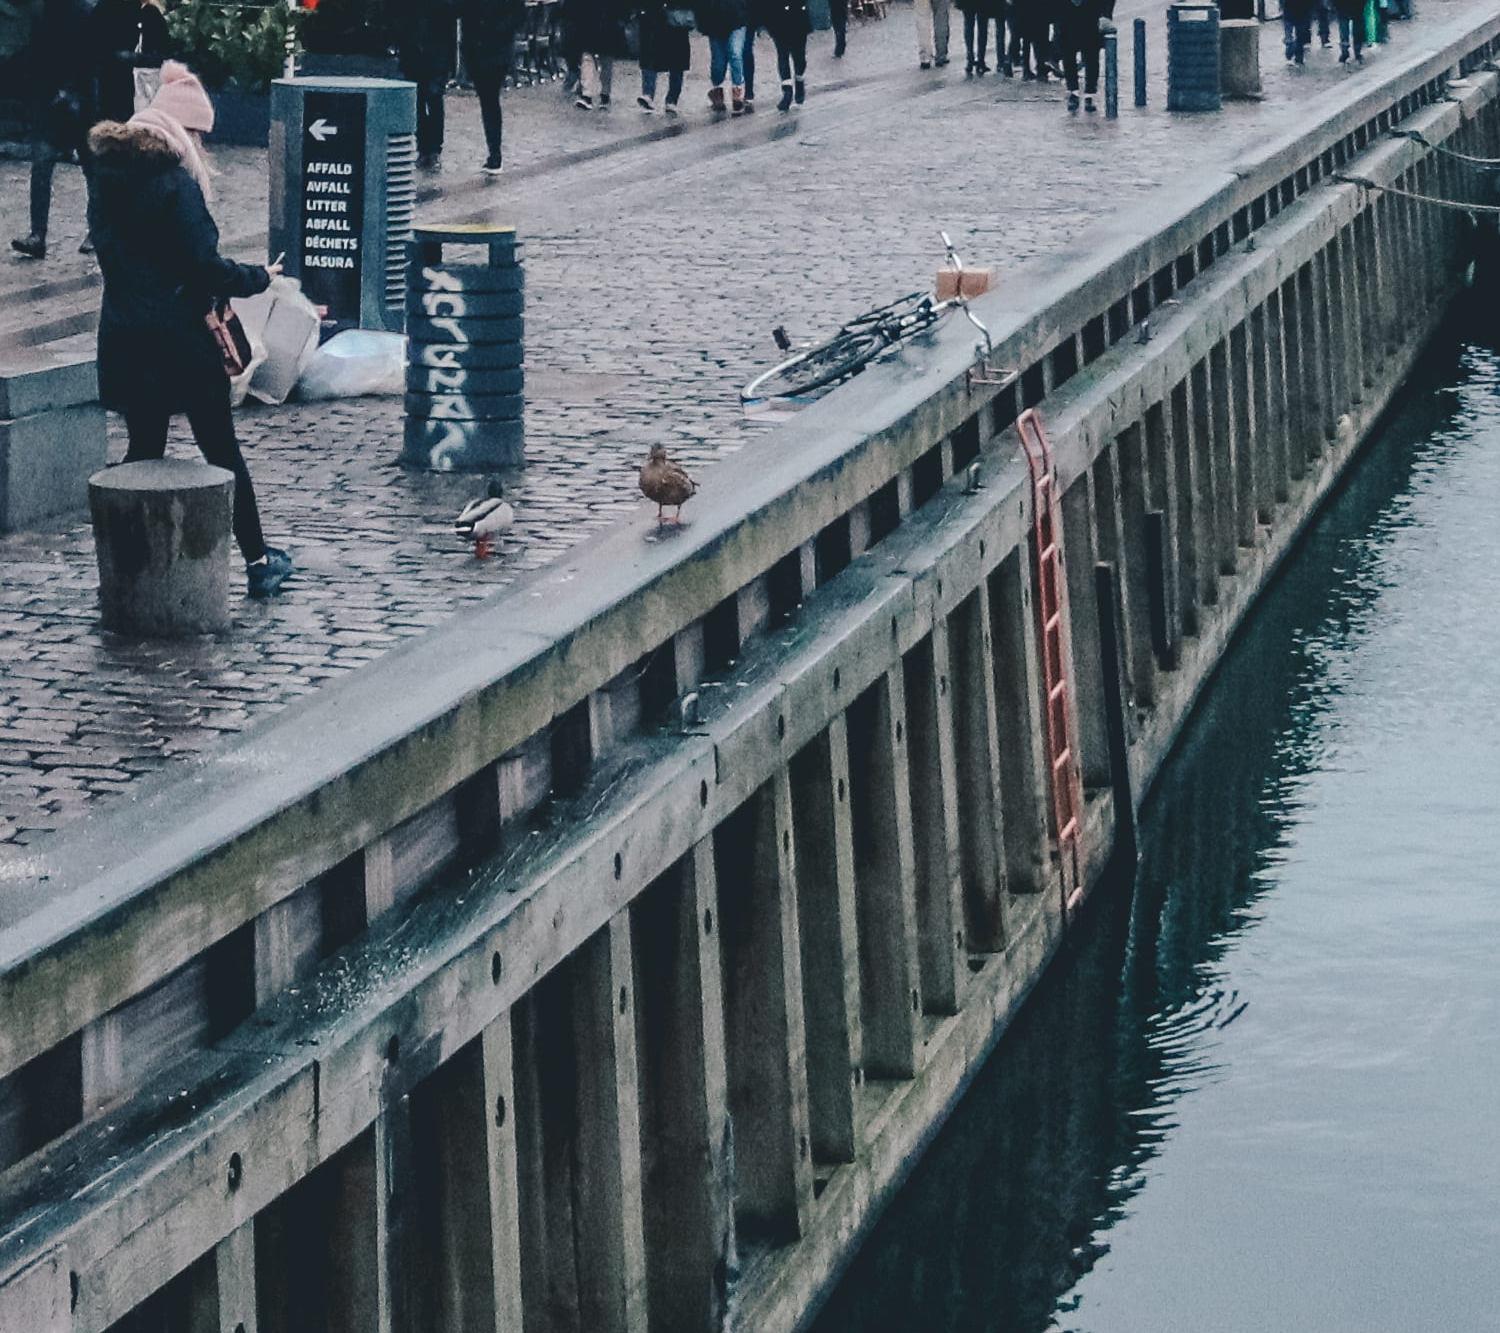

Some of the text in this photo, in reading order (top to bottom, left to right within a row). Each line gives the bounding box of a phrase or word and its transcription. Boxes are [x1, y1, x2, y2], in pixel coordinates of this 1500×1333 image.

[307, 162, 352, 175] AFFALD
[306, 181, 350, 194] AVFALL
[306, 199, 347, 212] LITTER
[306, 218, 350, 231] ABFALL
[305, 235, 358, 250] DÉCHETS
[305, 255, 354, 269] BASURA
